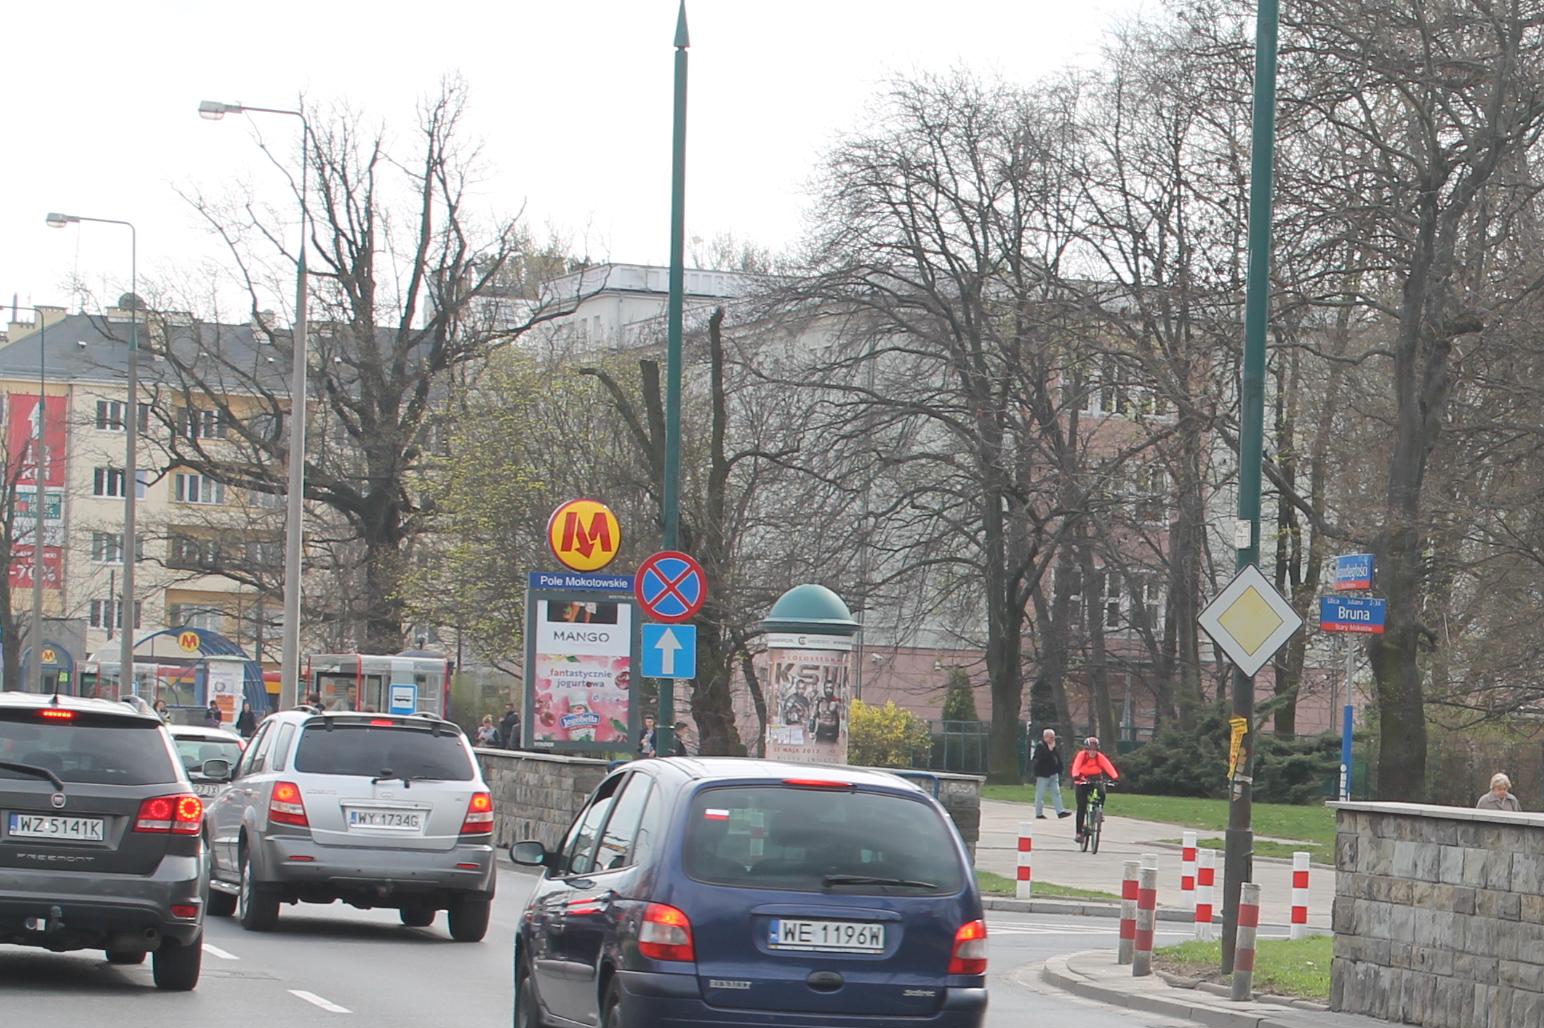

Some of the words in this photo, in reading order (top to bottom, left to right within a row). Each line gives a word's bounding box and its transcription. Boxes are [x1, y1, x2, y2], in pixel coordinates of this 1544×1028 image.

[540, 575, 563, 586] Pole
[565, 577, 628, 588] Mokotowskie
[1338, 606, 1370, 621] Bruna
[553, 631, 610, 642] MANGO
[549, 668, 613, 678] fantastycznie
[557, 680, 605, 689] jogurtowa
[21, 817, 44, 832] WZ
[50, 819, 100, 835] 5141K
[358, 811, 376, 824] WY
[382, 813, 418, 827] 1734G
[783, 923, 812, 943] WE
[821, 924, 881, 947] 1196W
